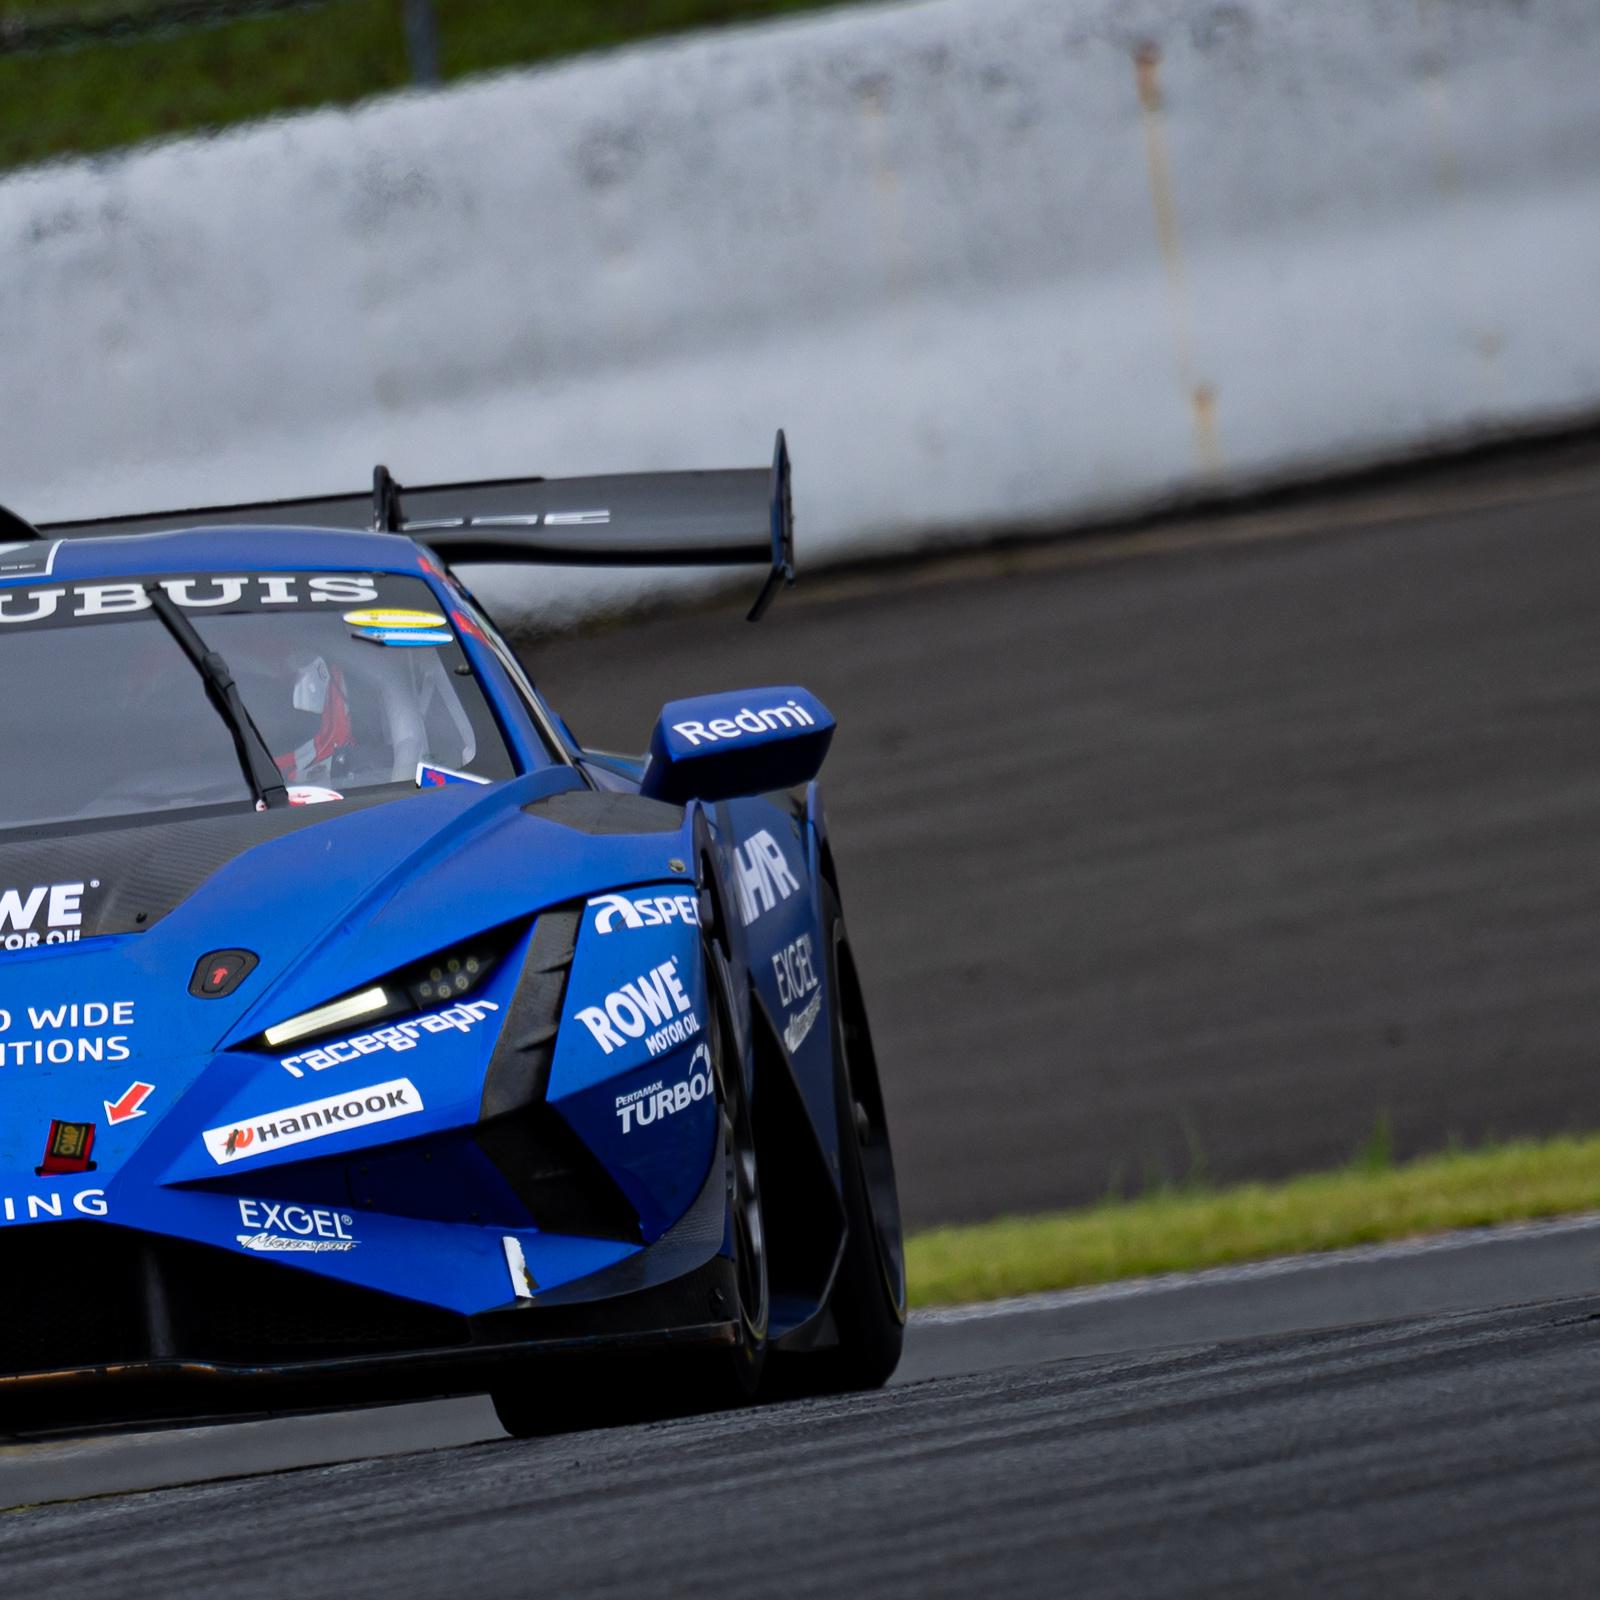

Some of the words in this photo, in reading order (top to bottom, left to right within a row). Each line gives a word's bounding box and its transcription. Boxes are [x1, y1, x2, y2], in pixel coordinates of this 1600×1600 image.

[672, 699, 816, 746] Redmi
[587, 894, 702, 935] ASPE
[27, 1001, 135, 1031] WIDE
[574, 959, 691, 1055] ROWE
[281, 1000, 499, 1078] racegraph
[645, 1022, 688, 1056] MOTOR
[616, 1073, 706, 1135] TURBO
